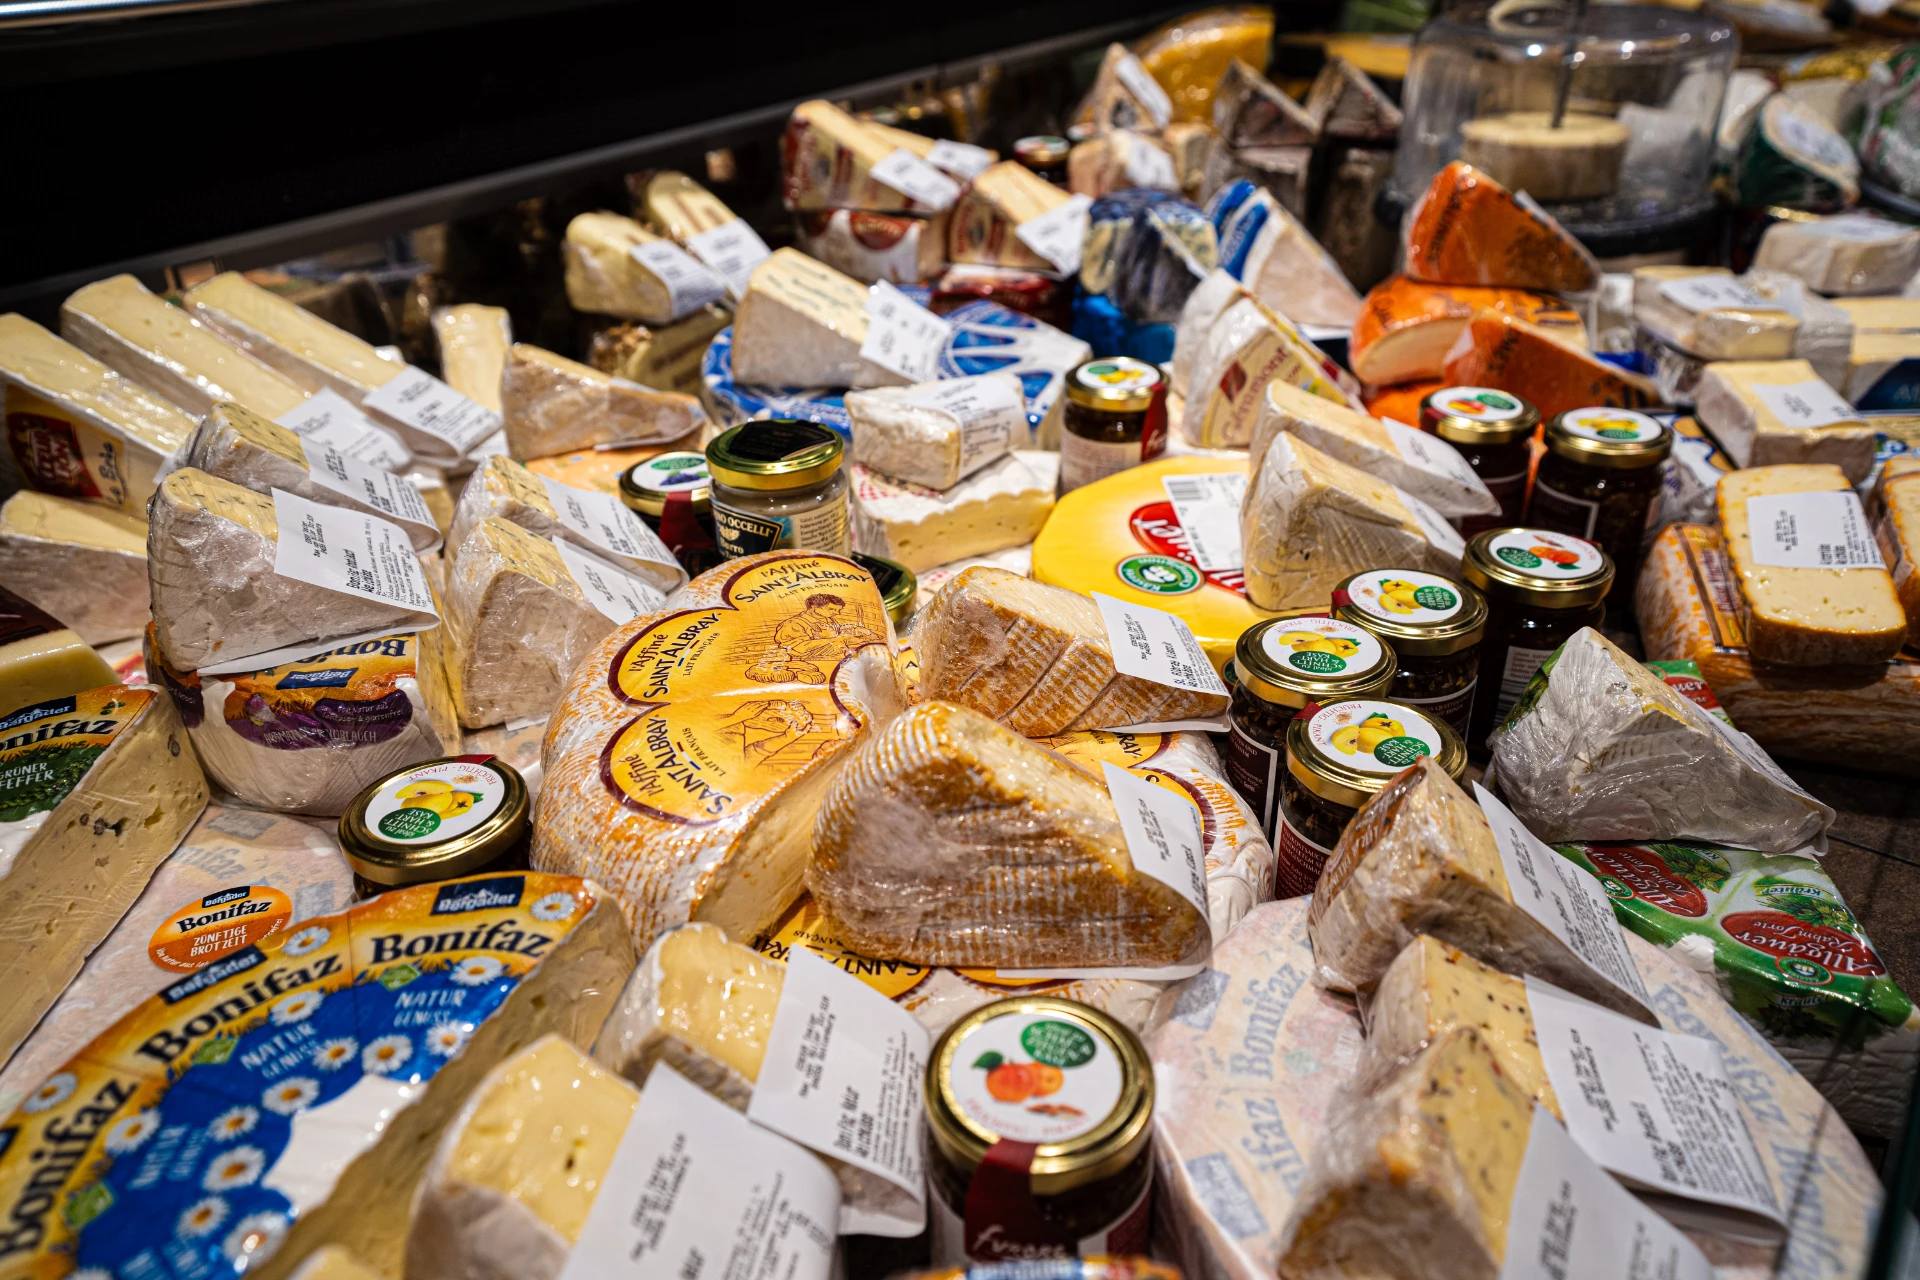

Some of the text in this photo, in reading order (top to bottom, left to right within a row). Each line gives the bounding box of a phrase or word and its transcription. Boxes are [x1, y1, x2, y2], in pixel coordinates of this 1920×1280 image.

[727, 516, 771, 537] OCCELLI
[761, 560, 822, 577] l'Affiné
[735, 570, 871, 603] SAINT ALBRAY
[1310, 619, 1359, 633] FRUCHTIG
[628, 634, 669, 672] l'Affiné
[643, 612, 722, 699] SAINT ALBRAY
[1312, 703, 1362, 746] FRUCHTIG PIKANT
[646, 714, 732, 814] SAINT ALBRAY
[1382, 743, 1407, 760] HART-
[1389, 741, 1425, 766] SCHNITT-
[408, 765, 498, 786] FRUCHTIG PIKANT
[624, 753, 665, 797] l'Affiné
[383, 818, 433, 835] SCHNITT-
[395, 813, 427, 825] HART-
[204, 891, 248, 907] Bergader
[1761, 886, 1822, 897] Kräuter
[176, 900, 273, 933] Bonifaz
[190, 934, 248, 957] BROTZEIT
[193, 924, 248, 946] ZÜNFTIGE
[369, 919, 554, 965] Bonifaz
[1735, 931, 1878, 972] Allgäuer
[136, 954, 343, 1063] Bonifaz
[394, 989, 468, 1009] NATUR
[1229, 962, 1309, 1082] Bonifaz
[240, 1022, 317, 1070] NATUR
[0, 1078, 138, 1257] Bonifaz
